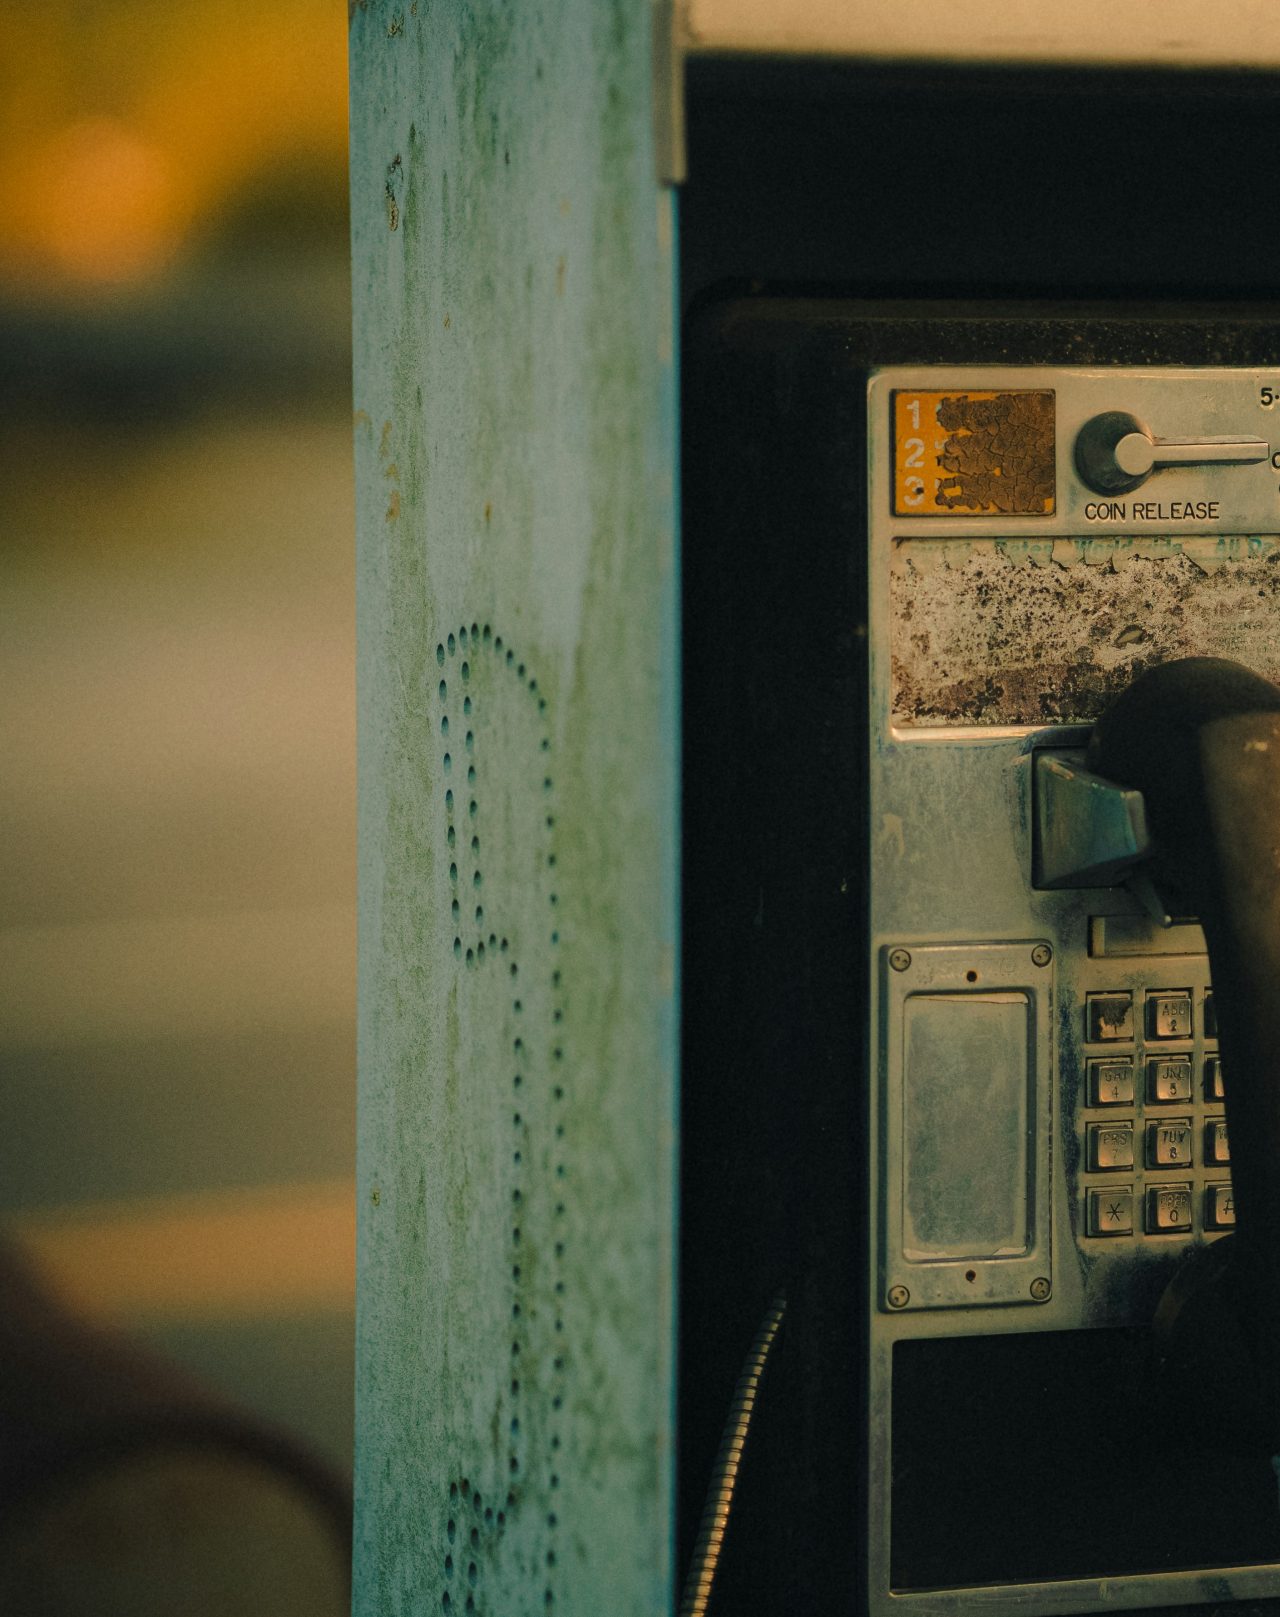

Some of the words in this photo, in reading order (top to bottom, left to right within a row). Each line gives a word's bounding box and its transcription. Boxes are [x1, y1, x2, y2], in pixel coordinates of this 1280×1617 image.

[906, 400, 920, 430] 1
[904, 438, 925, 468] 2
[904, 476, 925, 506] 3
[1085, 502, 1126, 520] COIN
[1132, 501, 1220, 520] RELEASE
[1168, 1019, 1178, 1032] 2
[1111, 1085, 1119, 1099] 4
[1169, 1082, 1177, 1096] 5
[1169, 1147, 1177, 1160] 8
